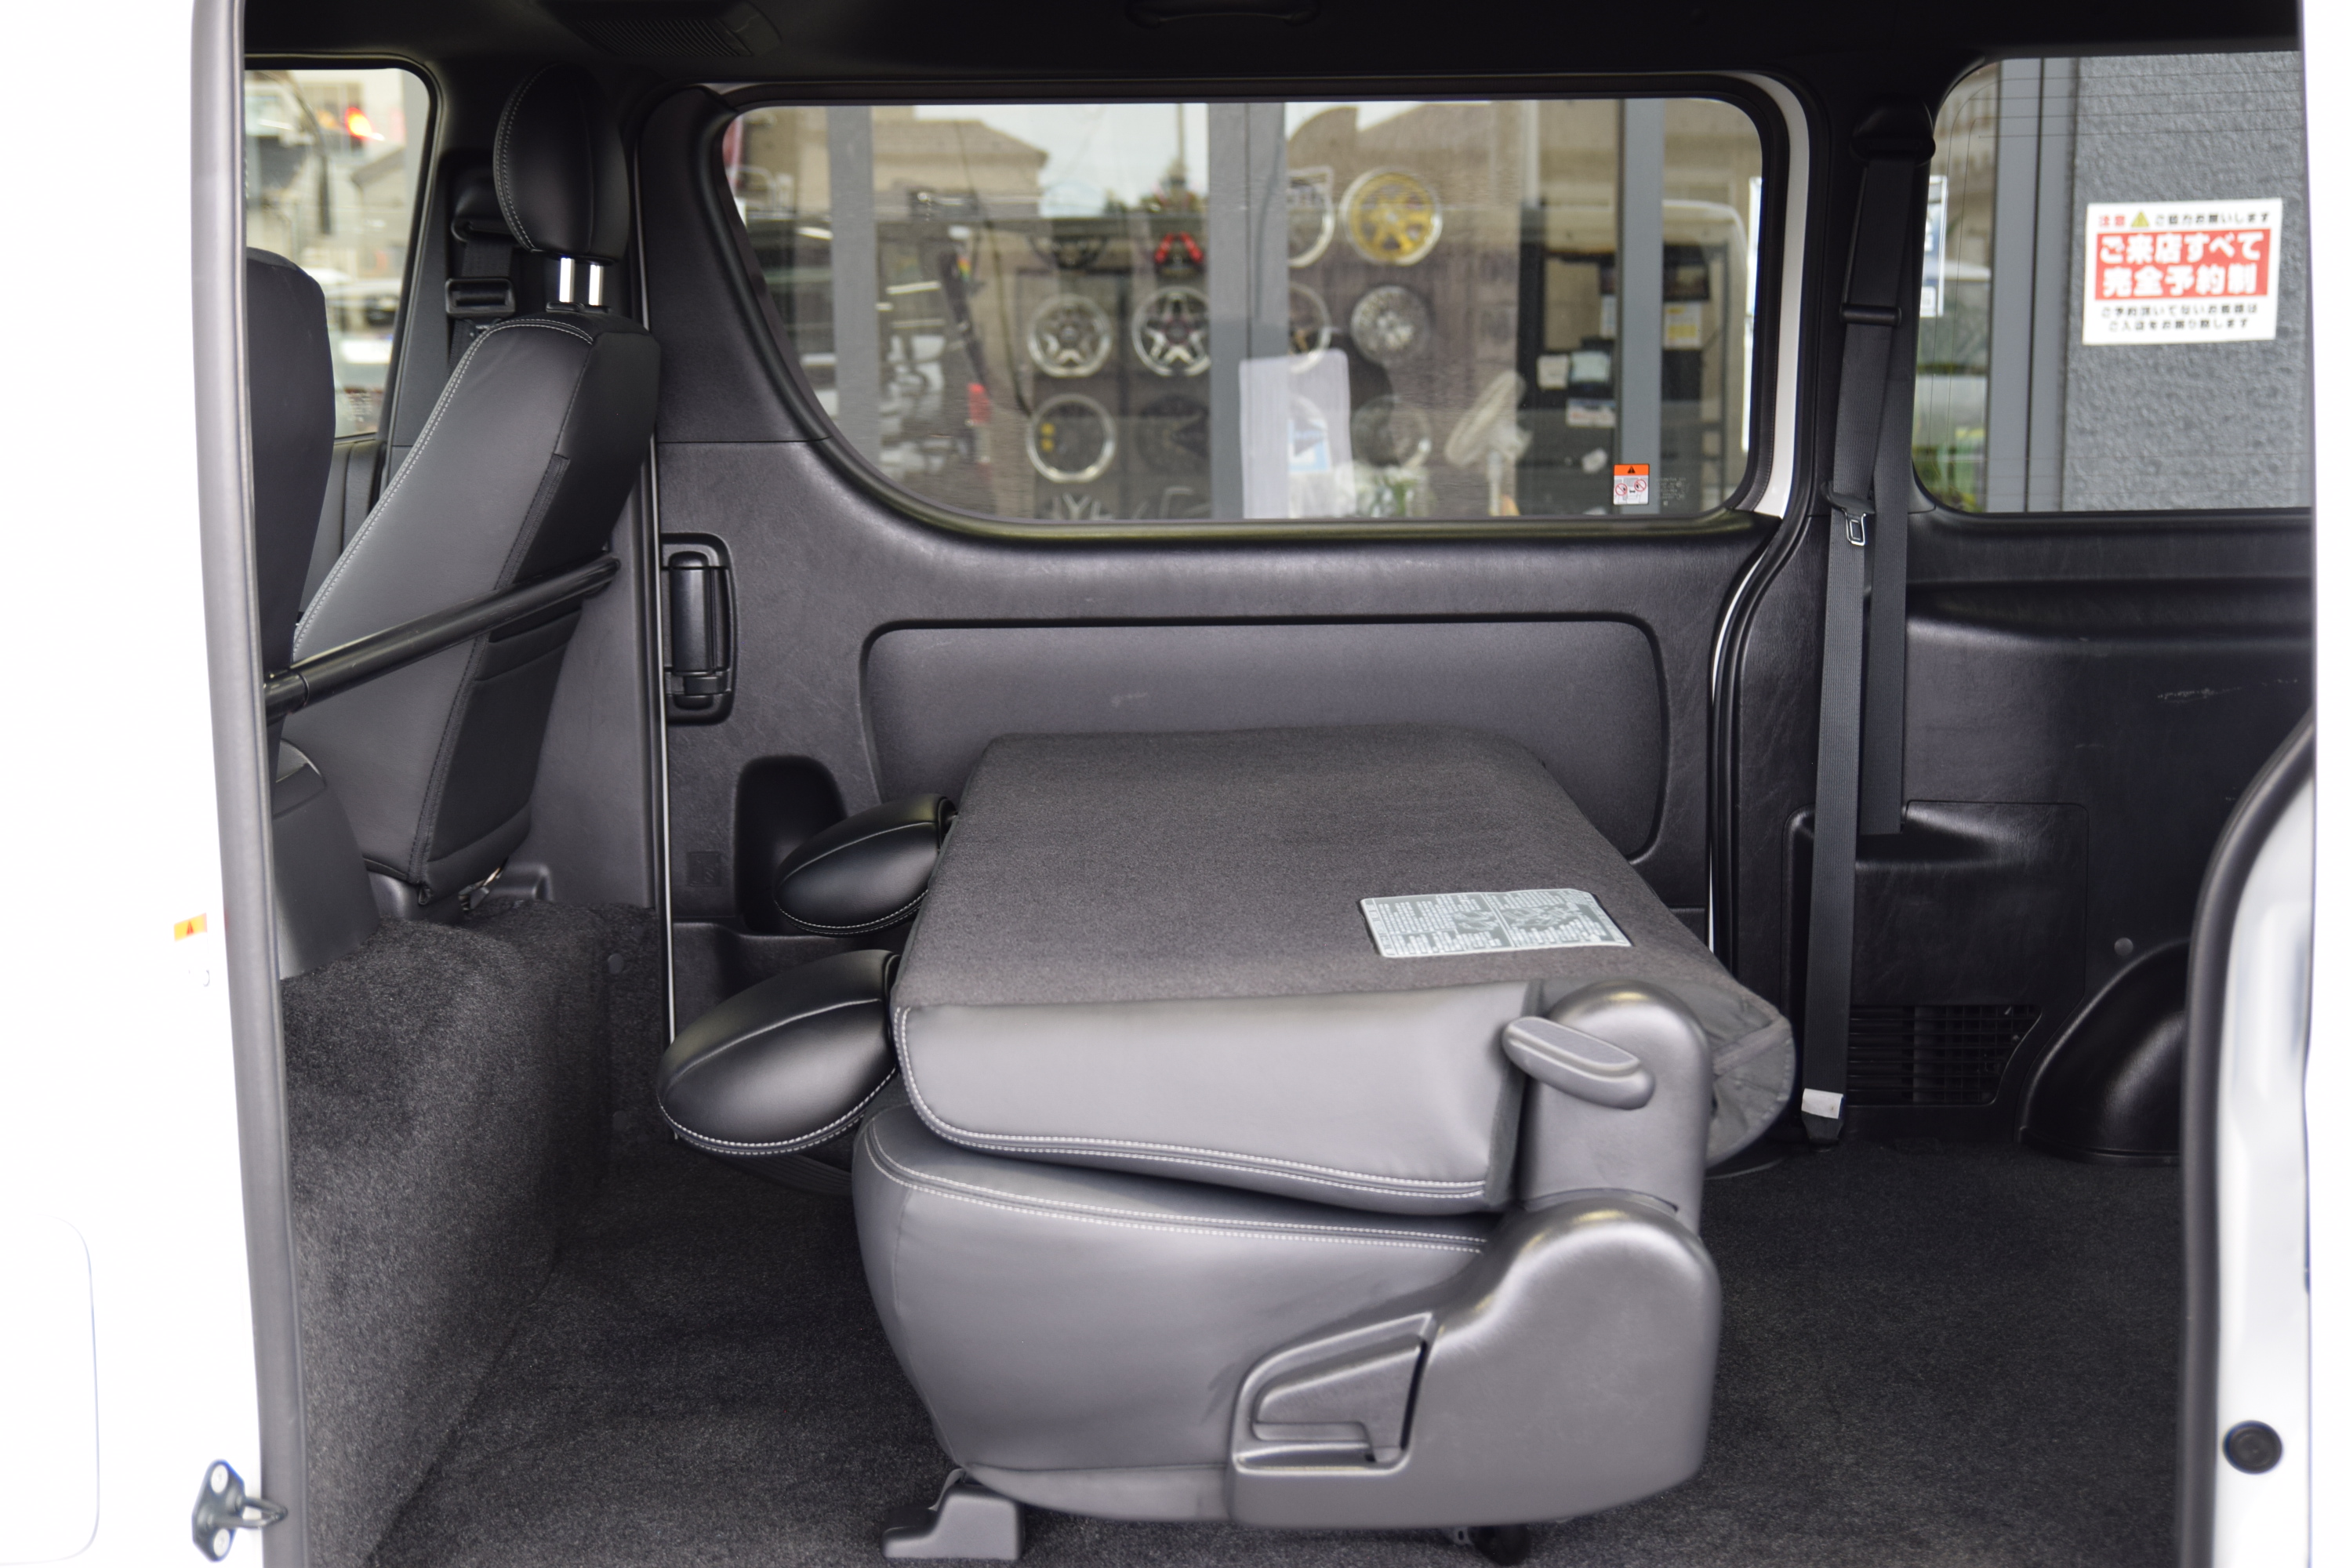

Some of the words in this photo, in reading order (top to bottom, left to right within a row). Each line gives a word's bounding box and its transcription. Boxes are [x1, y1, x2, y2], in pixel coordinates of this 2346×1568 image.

[2100, 232, 2264, 263] ご来店すべて
[2102, 263, 2257, 297] 完全予約制
